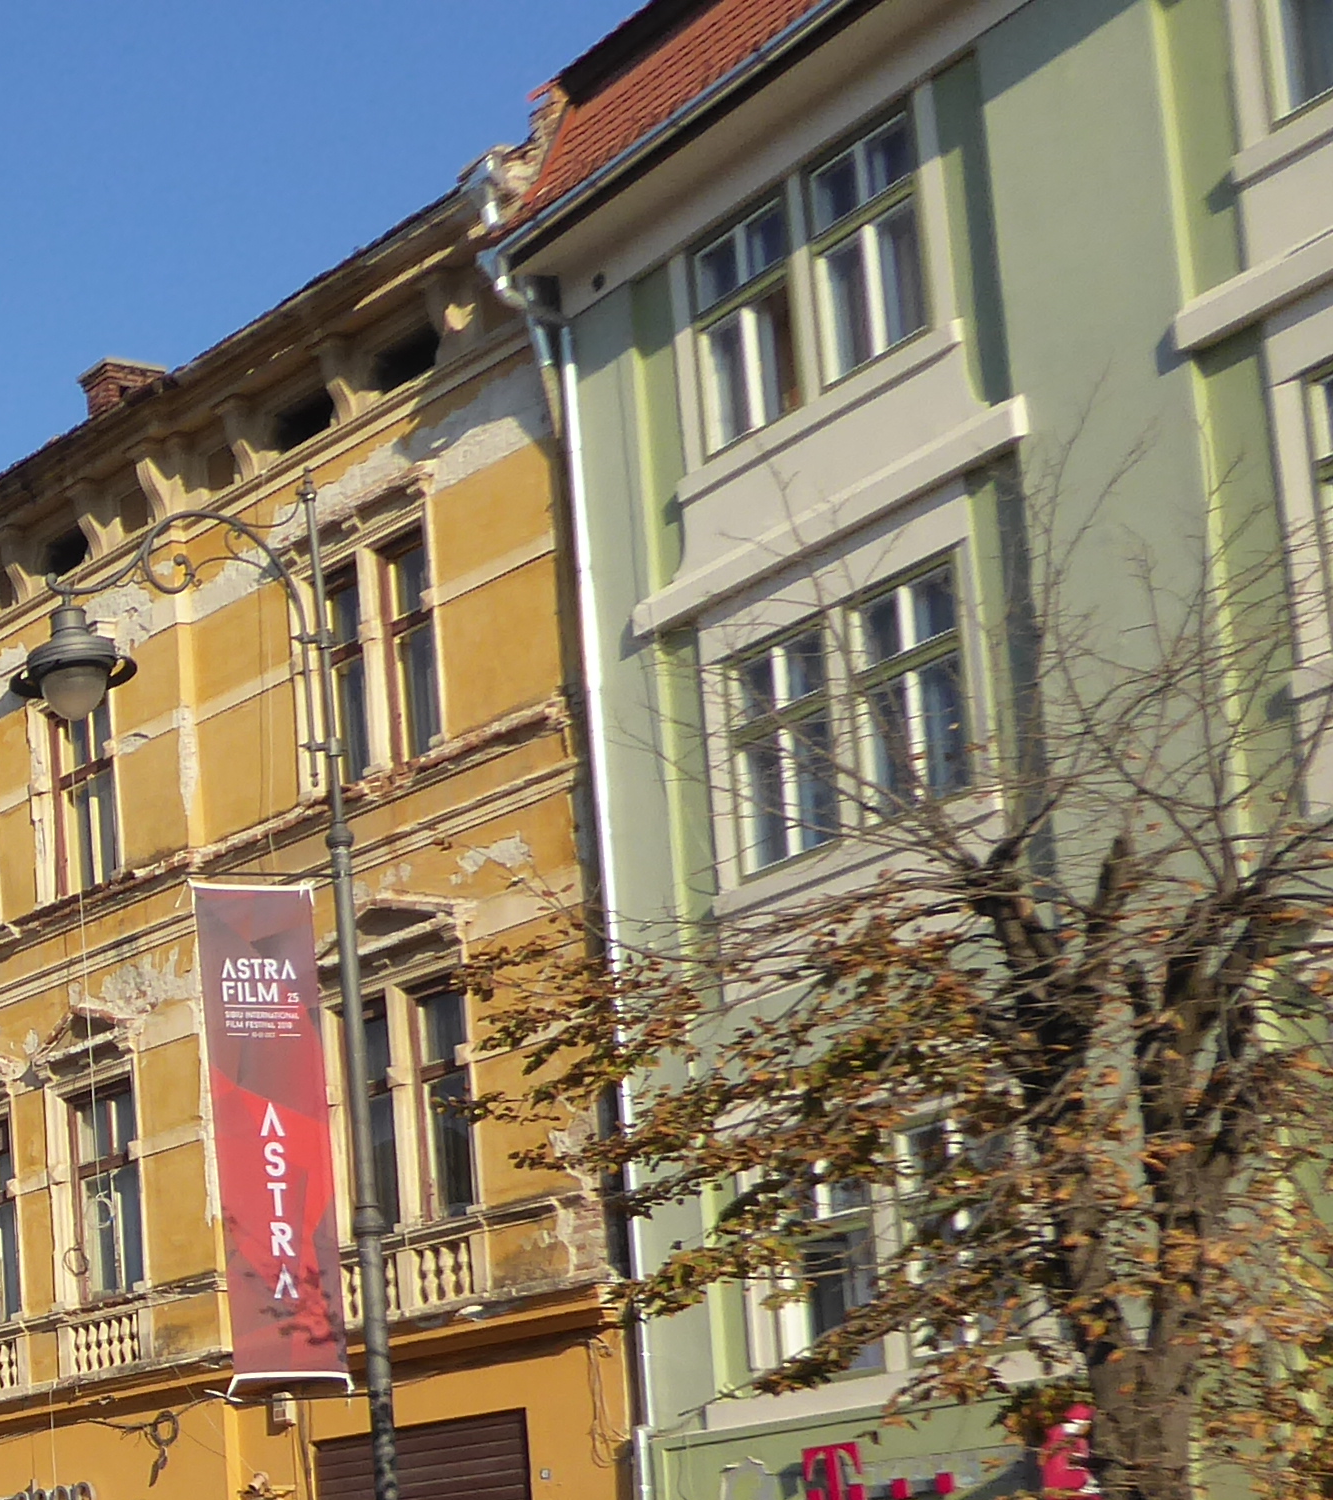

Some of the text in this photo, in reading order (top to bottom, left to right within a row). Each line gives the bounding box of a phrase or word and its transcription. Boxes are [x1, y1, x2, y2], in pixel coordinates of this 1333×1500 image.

[222, 957, 297, 980] ASTRA
[222, 981, 300, 1003] FILM 25
[260, 1102, 299, 1299] ASTRA
